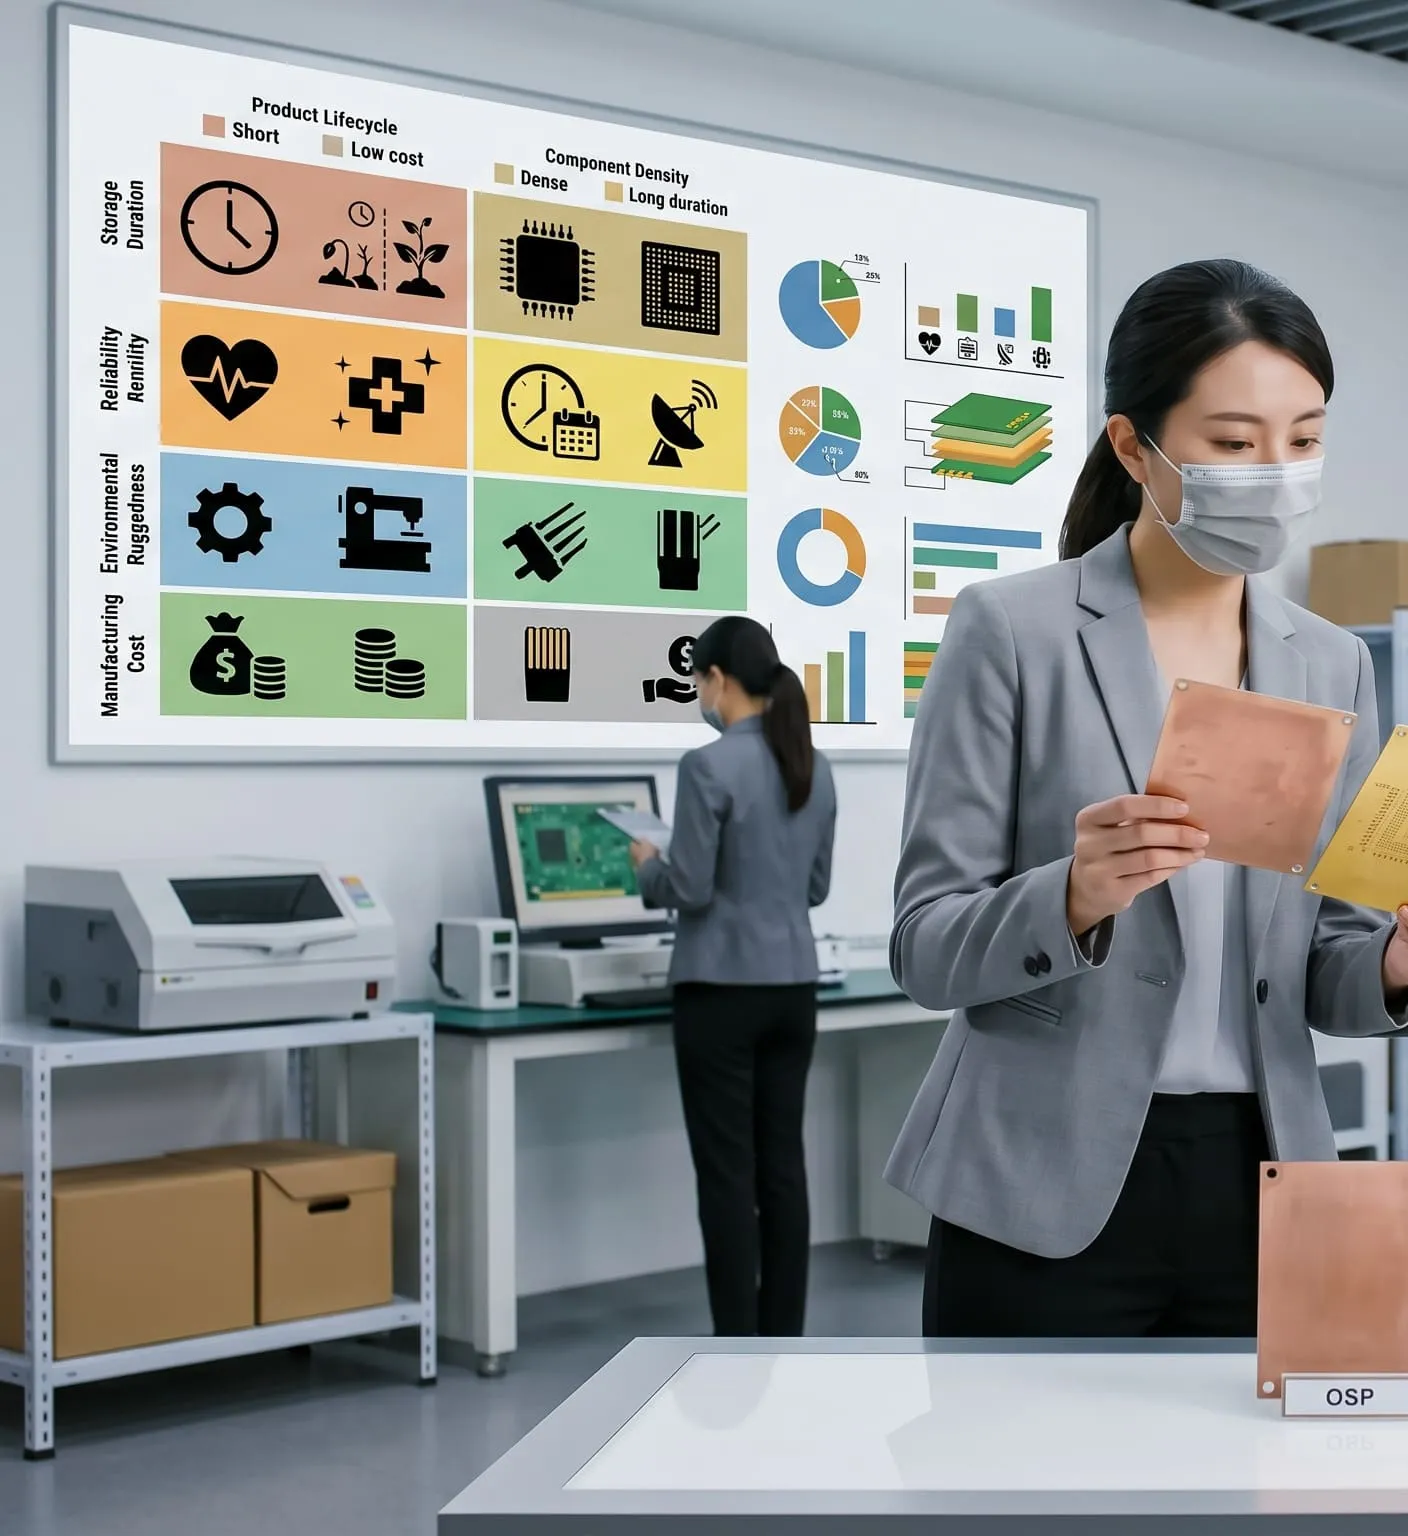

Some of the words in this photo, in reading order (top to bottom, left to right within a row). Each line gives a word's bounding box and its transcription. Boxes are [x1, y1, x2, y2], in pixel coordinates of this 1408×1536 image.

[233, 122, 281, 144] Short
[252, 96, 319, 123] Product
[324, 110, 397, 135] Lifecycle
[352, 140, 385, 161] Low
[389, 151, 424, 168] cost
[545, 148, 631, 176] Component
[636, 163, 688, 188] Density
[521, 169, 569, 192] Dense
[101, 181, 122, 245] Storage
[126, 181, 143, 249] Duration
[629, 188, 665, 210] Long
[670, 194, 727, 216] duration
[100, 326, 122, 411] Reliability
[100, 453, 118, 573] Environmental
[127, 464, 150, 565] Ruggedness
[101, 595, 123, 716] Manufacturing
[127, 635, 144, 672] Cost
[1326, 1388, 1374, 1406] OSP
